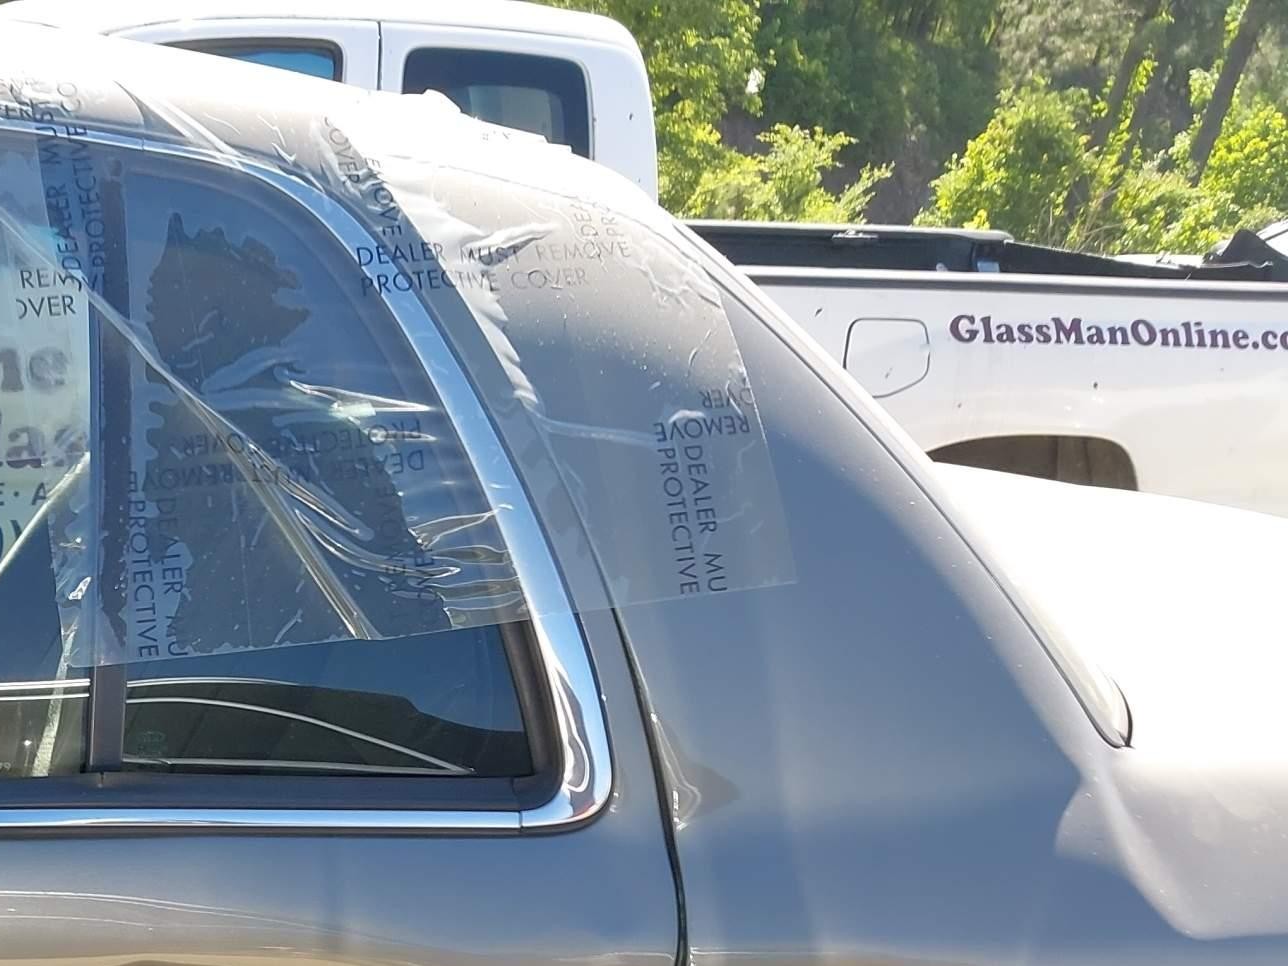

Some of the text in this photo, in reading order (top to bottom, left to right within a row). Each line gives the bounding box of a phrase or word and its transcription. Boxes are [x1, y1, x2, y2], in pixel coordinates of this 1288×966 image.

[356, 243, 445, 267] DEALER
[534, 241, 632, 261] REMOVE
[360, 267, 589, 297] PROTECTIVE COVER
[653, 413, 750, 442] REMOVE
[683, 444, 718, 534] DEALER
[656, 447, 700, 595] PROTECTIVE
[128, 501, 160, 657] PROTECTIVE
